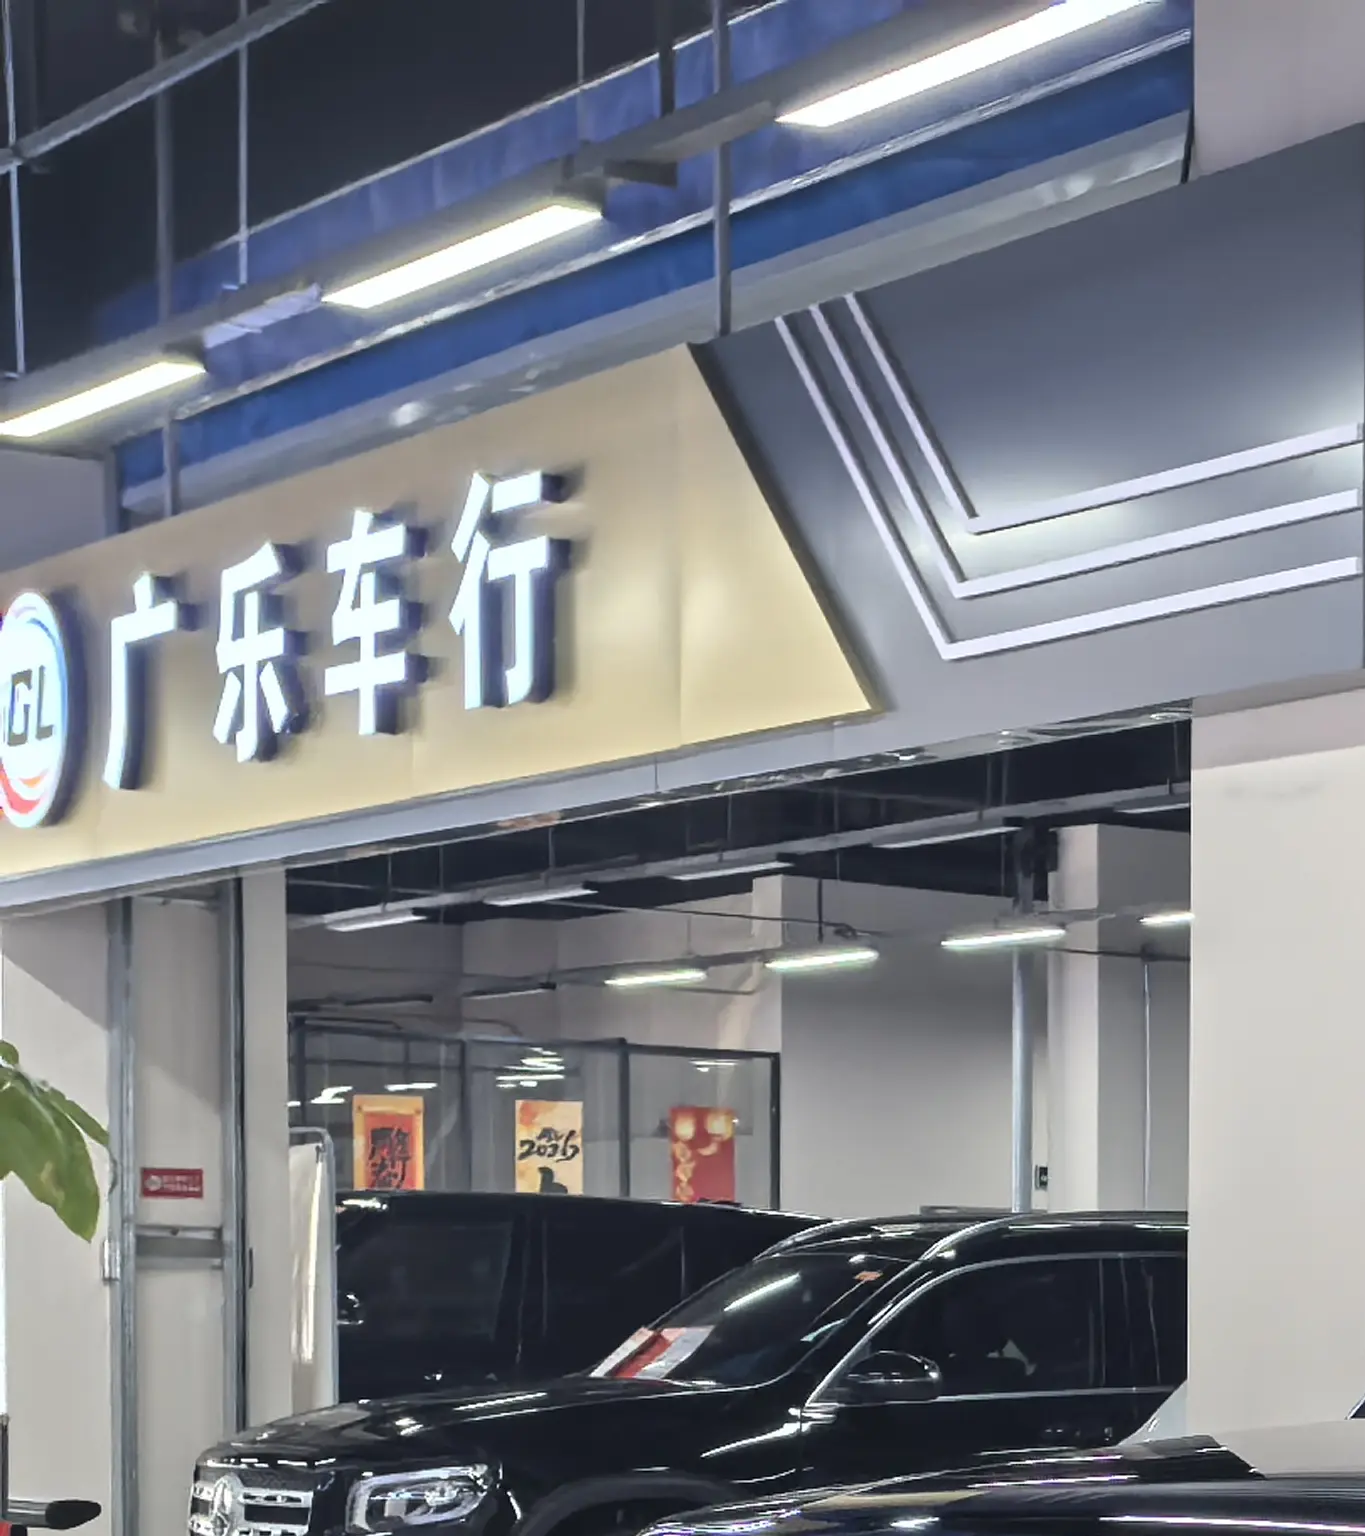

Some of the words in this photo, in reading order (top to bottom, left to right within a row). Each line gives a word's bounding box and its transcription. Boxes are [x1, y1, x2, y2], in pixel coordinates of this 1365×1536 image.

[6, 665, 54, 747] GL
[103, 471, 566, 789] 广乐车行
